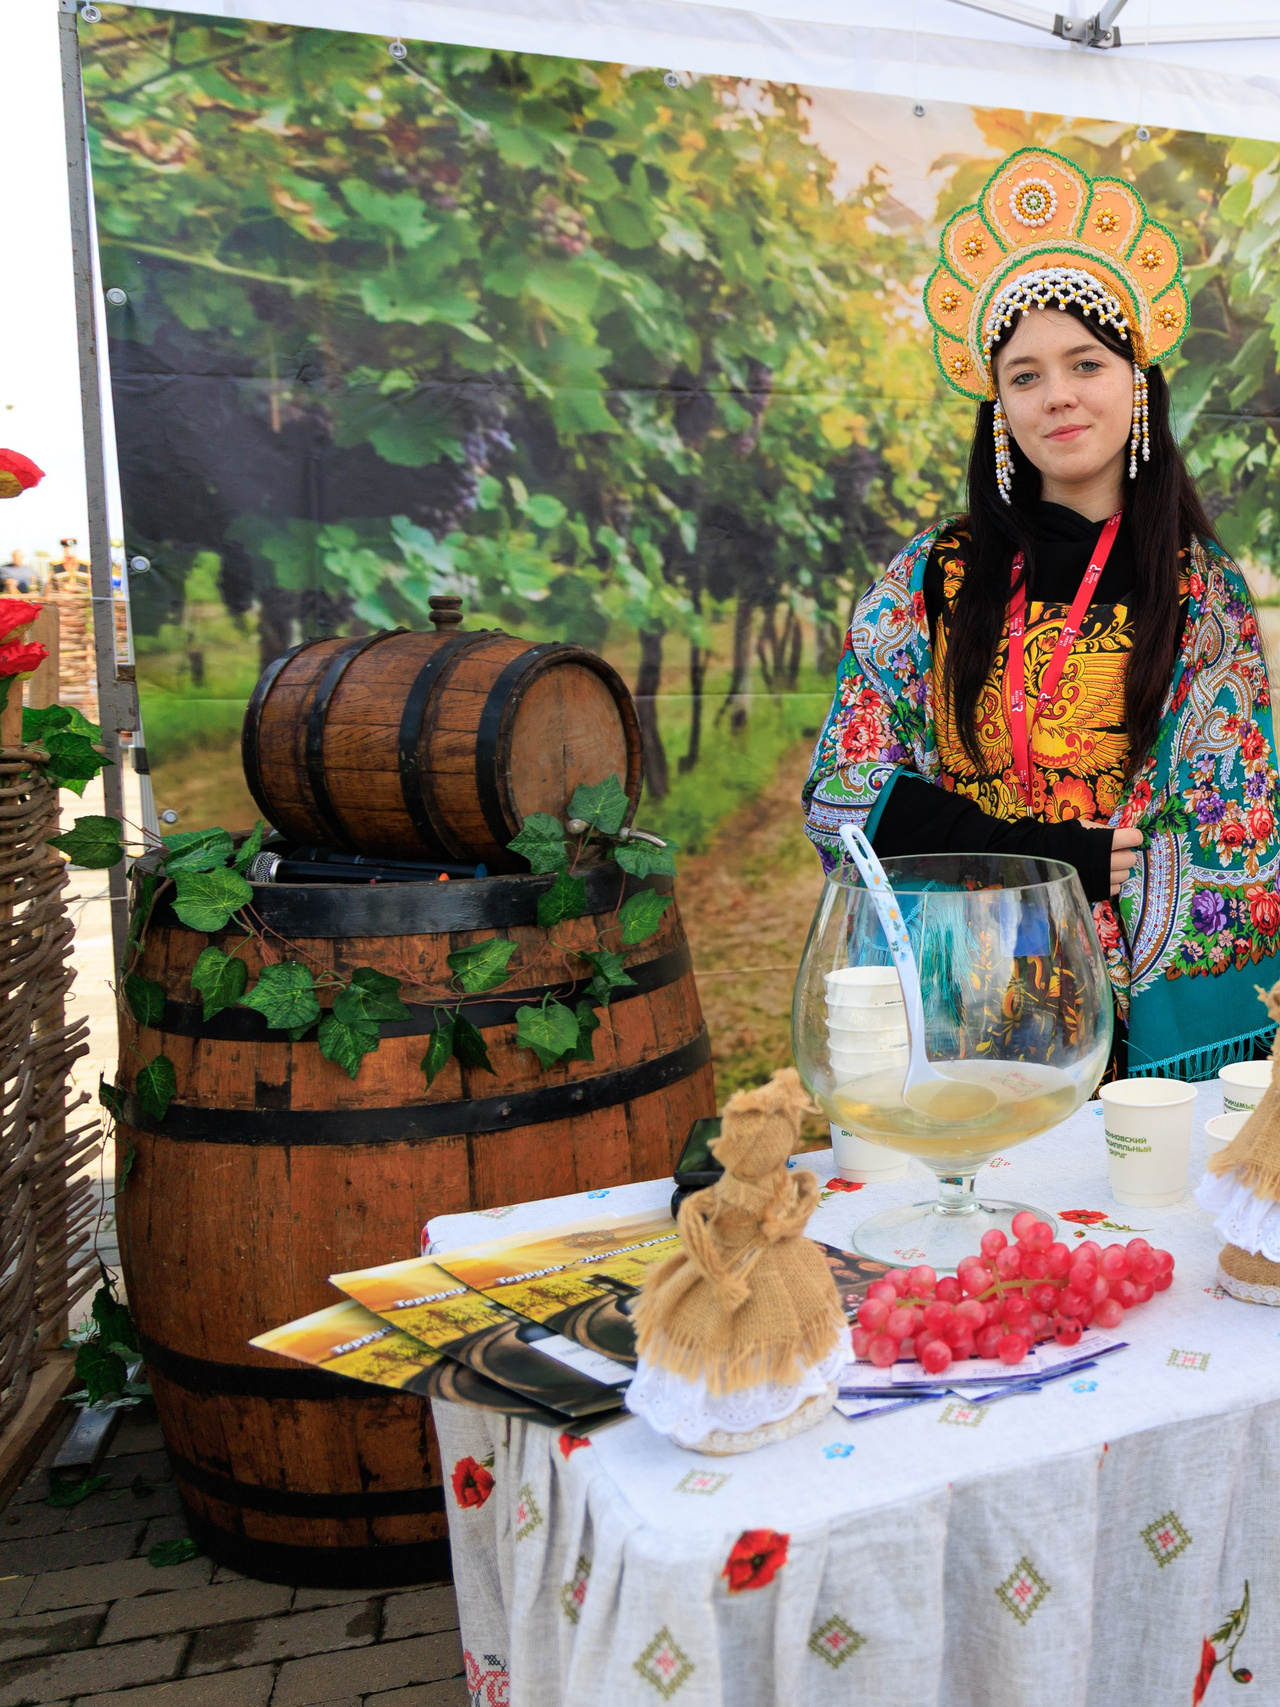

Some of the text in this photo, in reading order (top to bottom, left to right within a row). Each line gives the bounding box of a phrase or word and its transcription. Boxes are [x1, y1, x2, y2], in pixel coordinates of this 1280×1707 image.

[497, 1264, 565, 1284] Терруар
[642, 1234, 679, 1247] реки
[394, 1287, 468, 1308] Терруар
